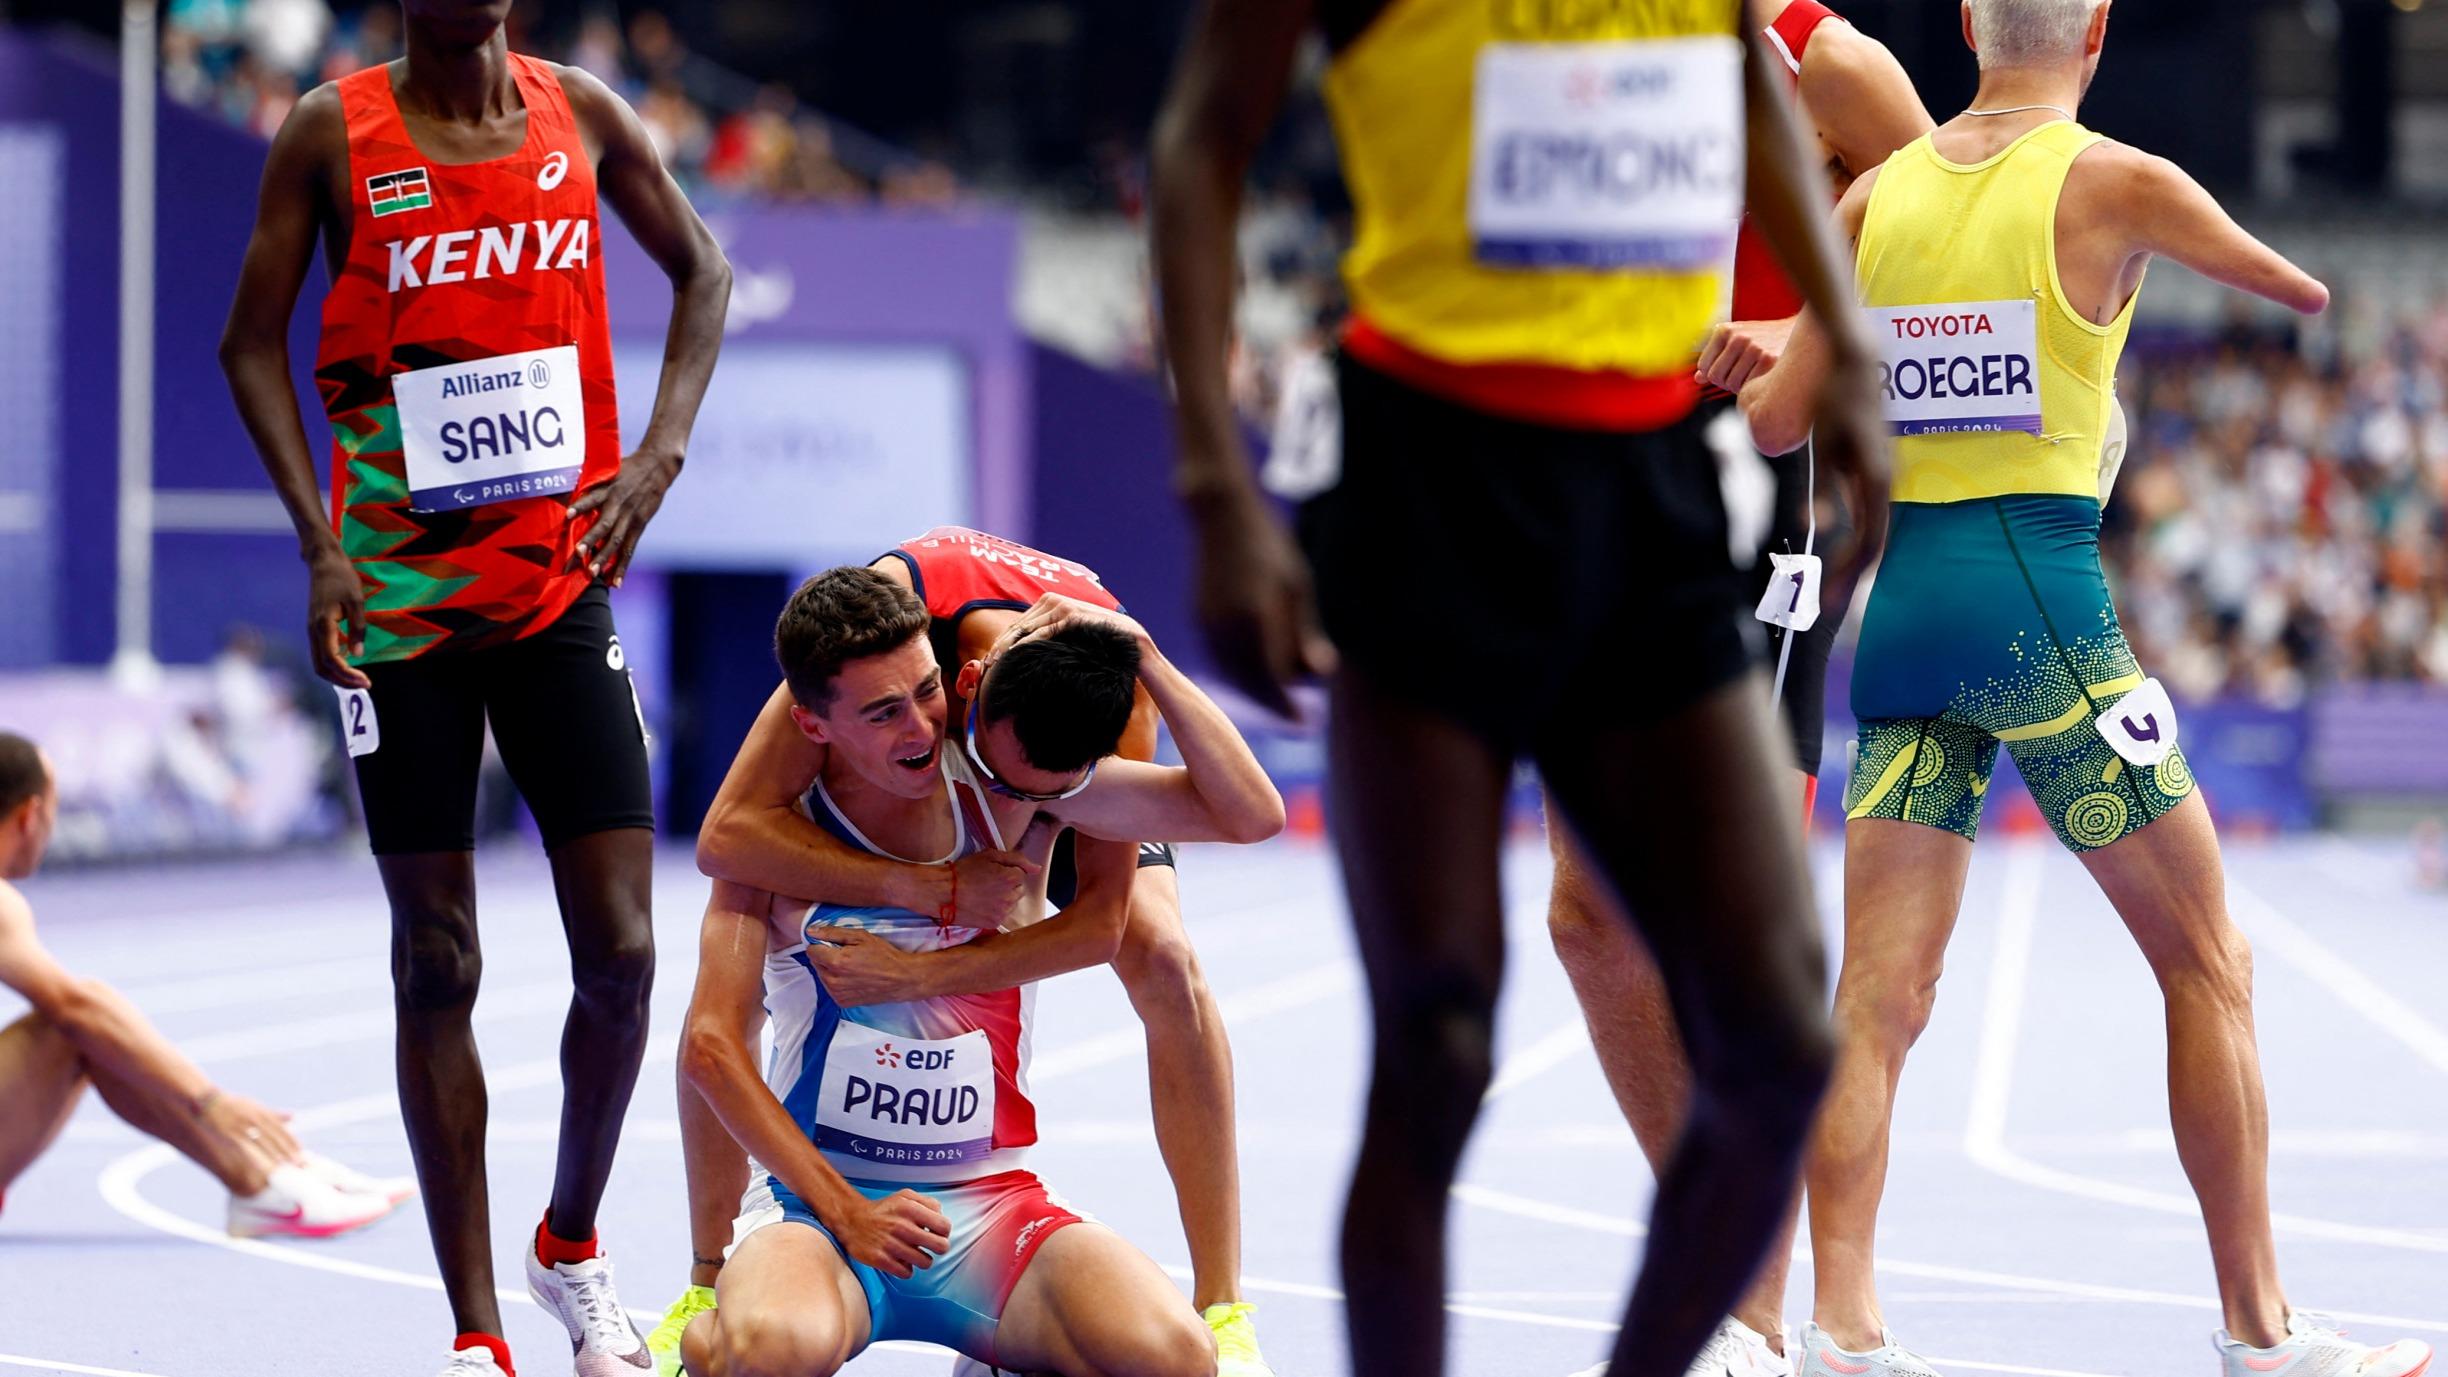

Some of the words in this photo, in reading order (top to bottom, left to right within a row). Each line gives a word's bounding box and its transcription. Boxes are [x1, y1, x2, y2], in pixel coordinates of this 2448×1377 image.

[385, 218, 590, 293] KENYA
[1891, 314, 1993, 338] TOYOTA
[442, 370, 523, 399] Allianz
[440, 406, 564, 463] SANG
[534, 475, 568, 490] 2024
[970, 545, 1060, 582] TEAM
[1788, 570, 1804, 612] 1
[350, 693, 366, 736] 2
[2120, 713, 2160, 744] 4
[843, 1074, 979, 1126] PRAUD
[926, 1148, 962, 1161] 2024
